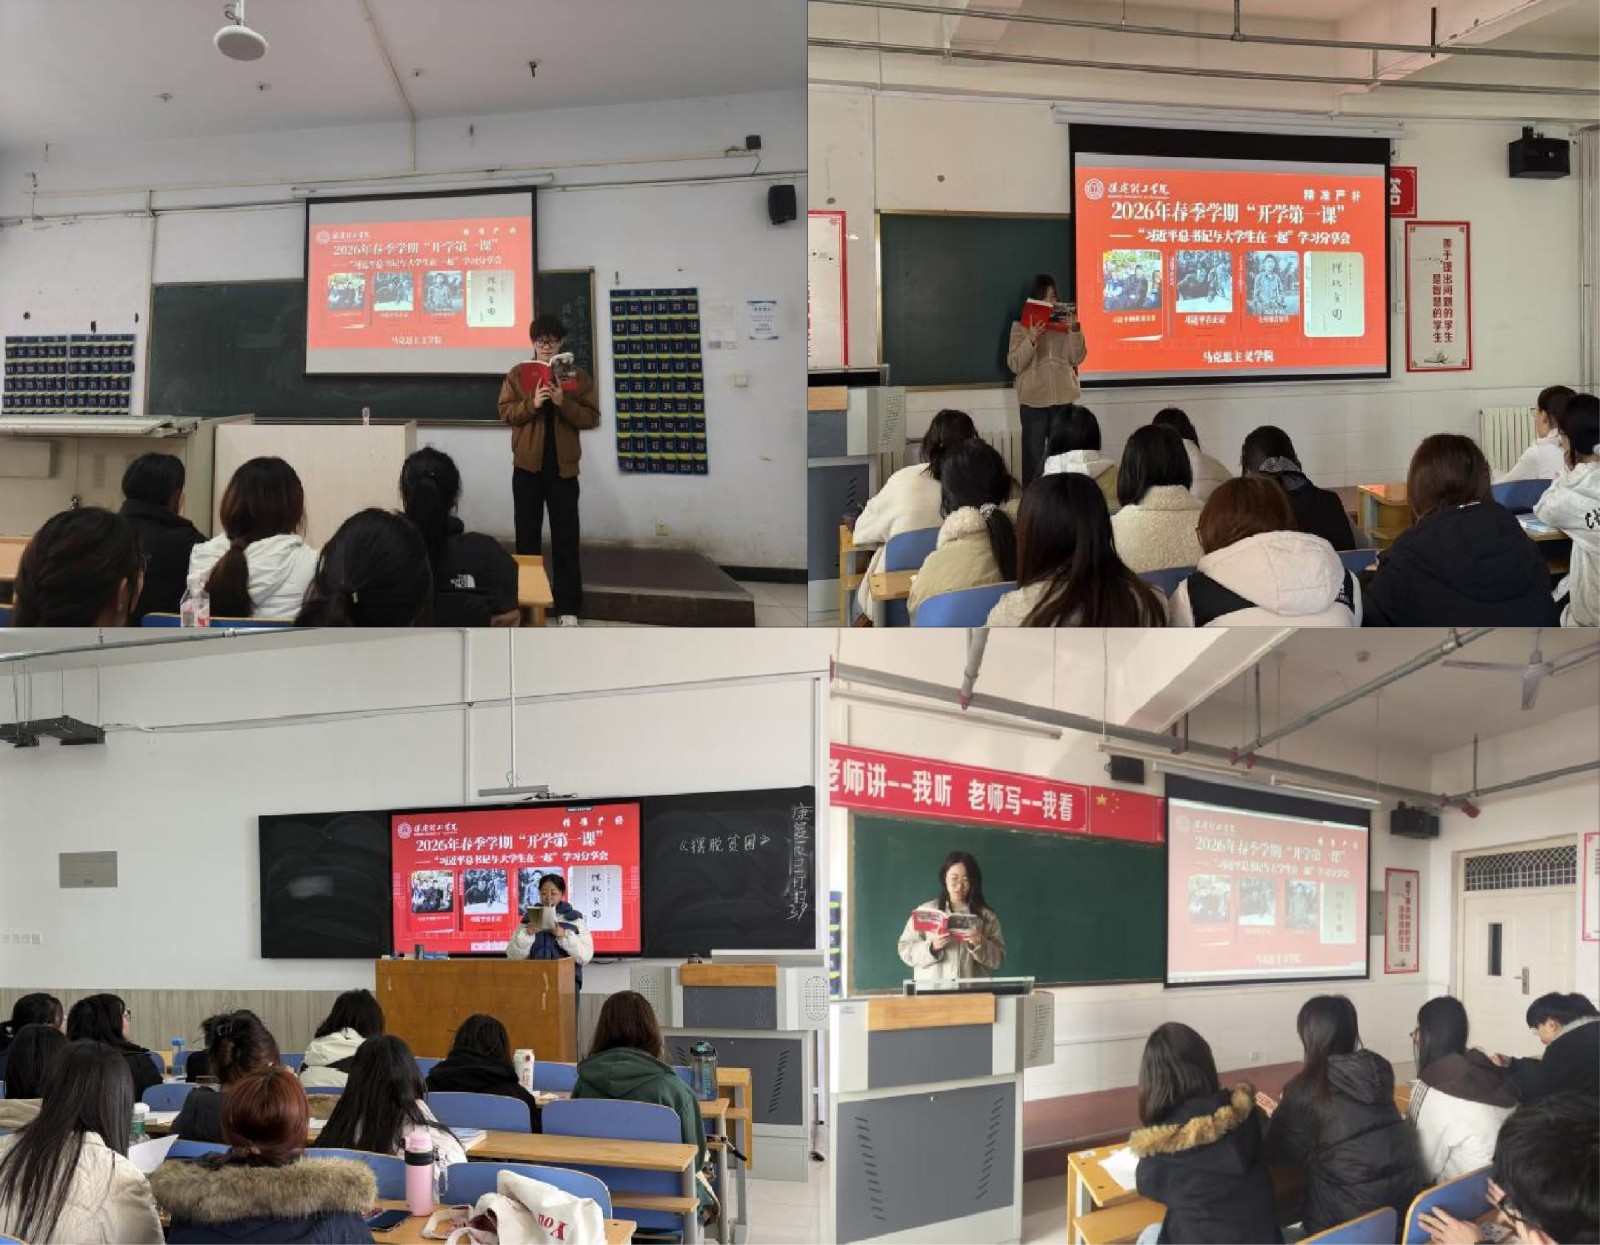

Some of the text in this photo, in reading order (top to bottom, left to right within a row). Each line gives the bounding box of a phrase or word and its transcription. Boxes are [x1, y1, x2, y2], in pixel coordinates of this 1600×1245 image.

[1432, 273, 1442, 343] 是智慧的学生
[1442, 238, 1453, 343] 善于提出问题的学生
